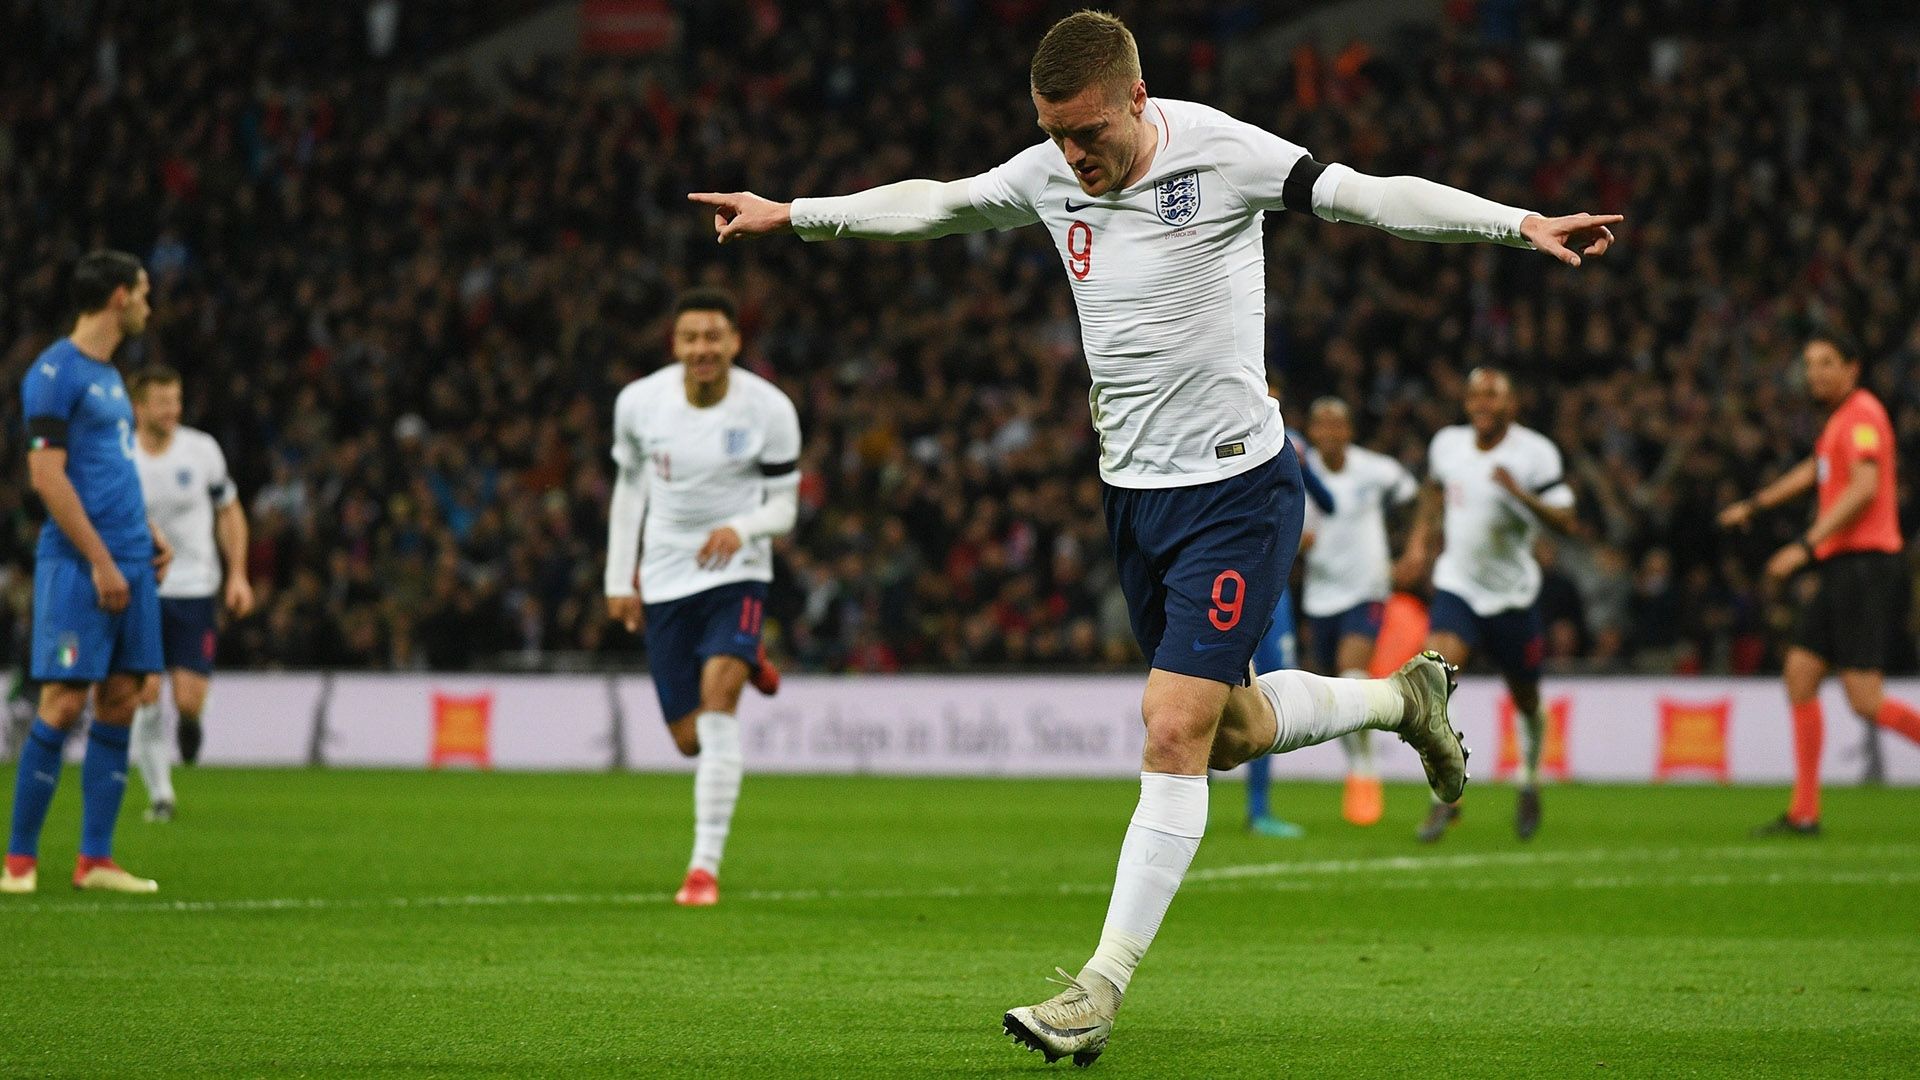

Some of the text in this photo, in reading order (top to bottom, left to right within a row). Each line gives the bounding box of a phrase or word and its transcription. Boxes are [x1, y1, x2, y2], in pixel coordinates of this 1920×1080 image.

[1068, 220, 1092, 280] 9
[1171, 231, 1186, 239] MARCH
[739, 594, 763, 635] 11
[1207, 569, 1246, 632] 9
